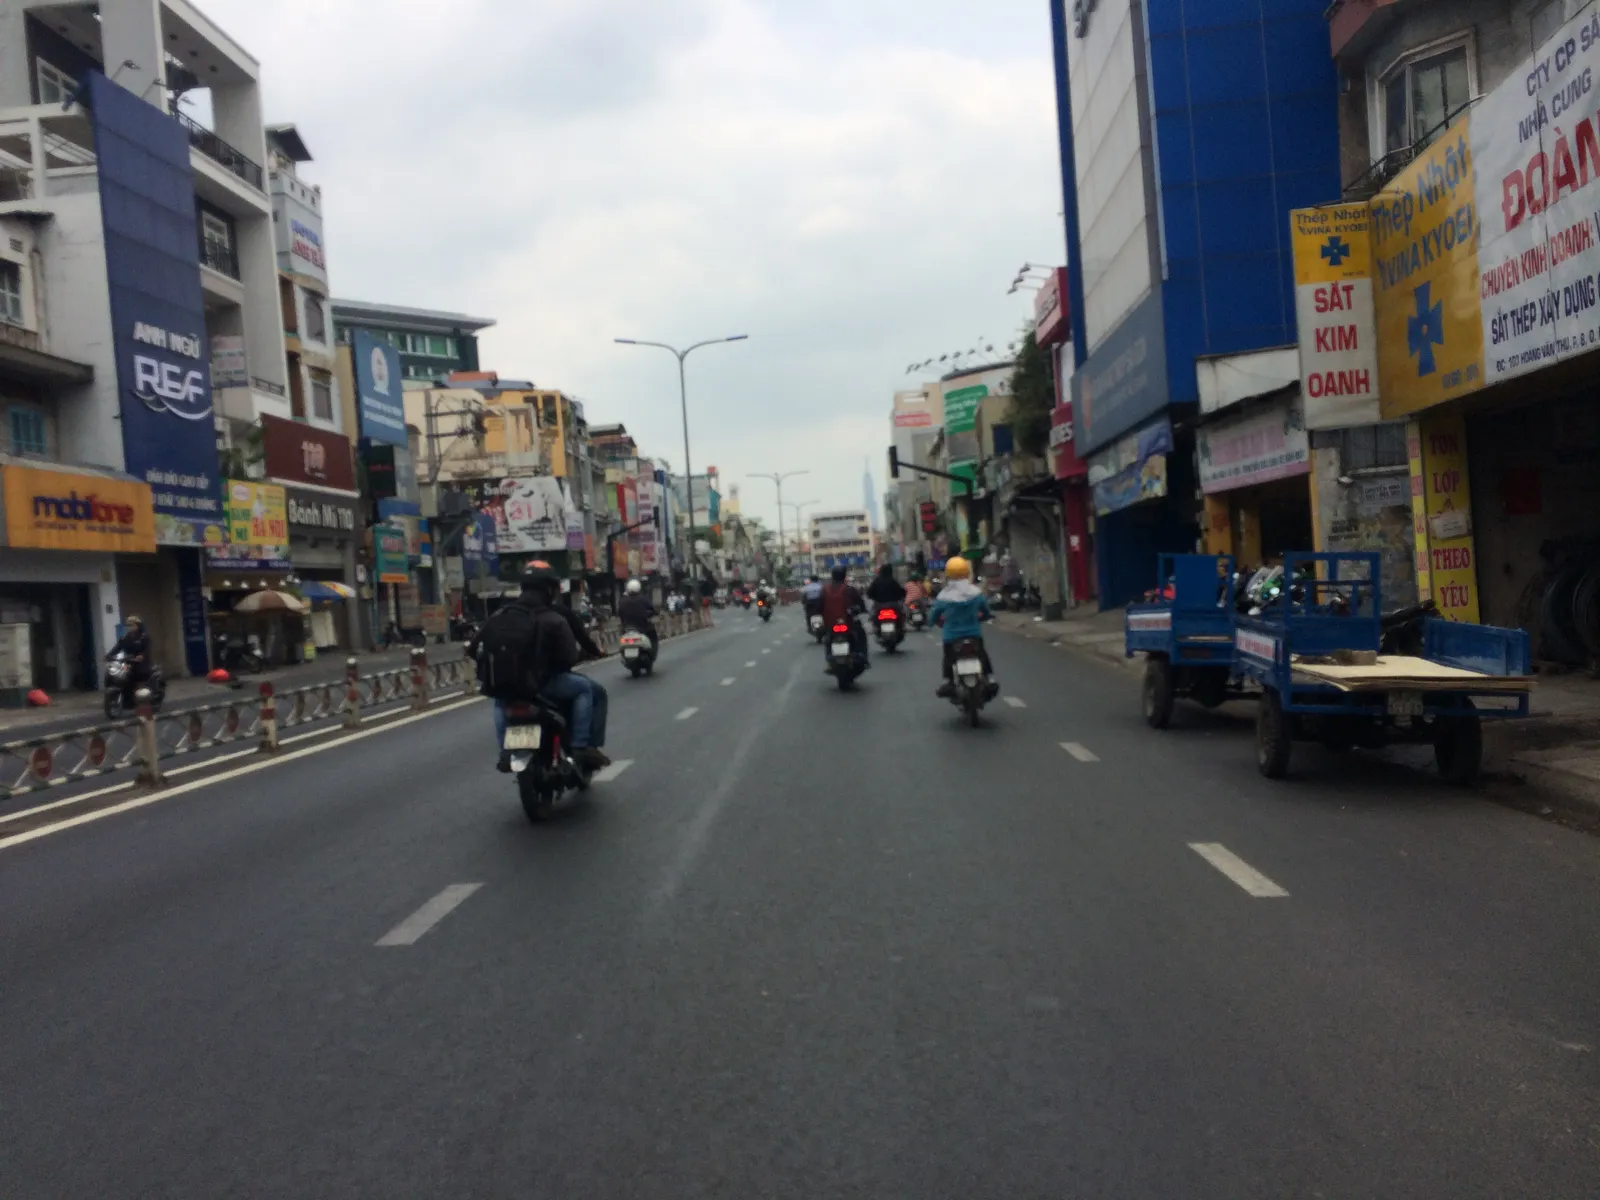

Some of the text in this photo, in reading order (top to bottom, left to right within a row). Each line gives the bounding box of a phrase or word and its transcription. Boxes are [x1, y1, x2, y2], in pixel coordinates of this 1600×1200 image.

[1526, 56, 1551, 96] CTY
[1555, 37, 1576, 72] CP
[1519, 67, 1592, 143] NHÀ CUNG
[1372, 187, 1414, 245] Thép
[1480, 255, 1520, 299] CHUYÊN
[1521, 242, 1547, 282] KINH
[1314, 280, 1354, 313] SẮT
[1510, 298, 1537, 337] THÉP
[1539, 288, 1560, 326] XÂY
[133, 321, 167, 349] ANH
[1315, 324, 1358, 352] KIM
[1308, 368, 1370, 398] OANH
[33, 490, 134, 525] mobifone
[1433, 547, 1470, 570] THEO
[1440, 580, 1469, 608] YÊU
